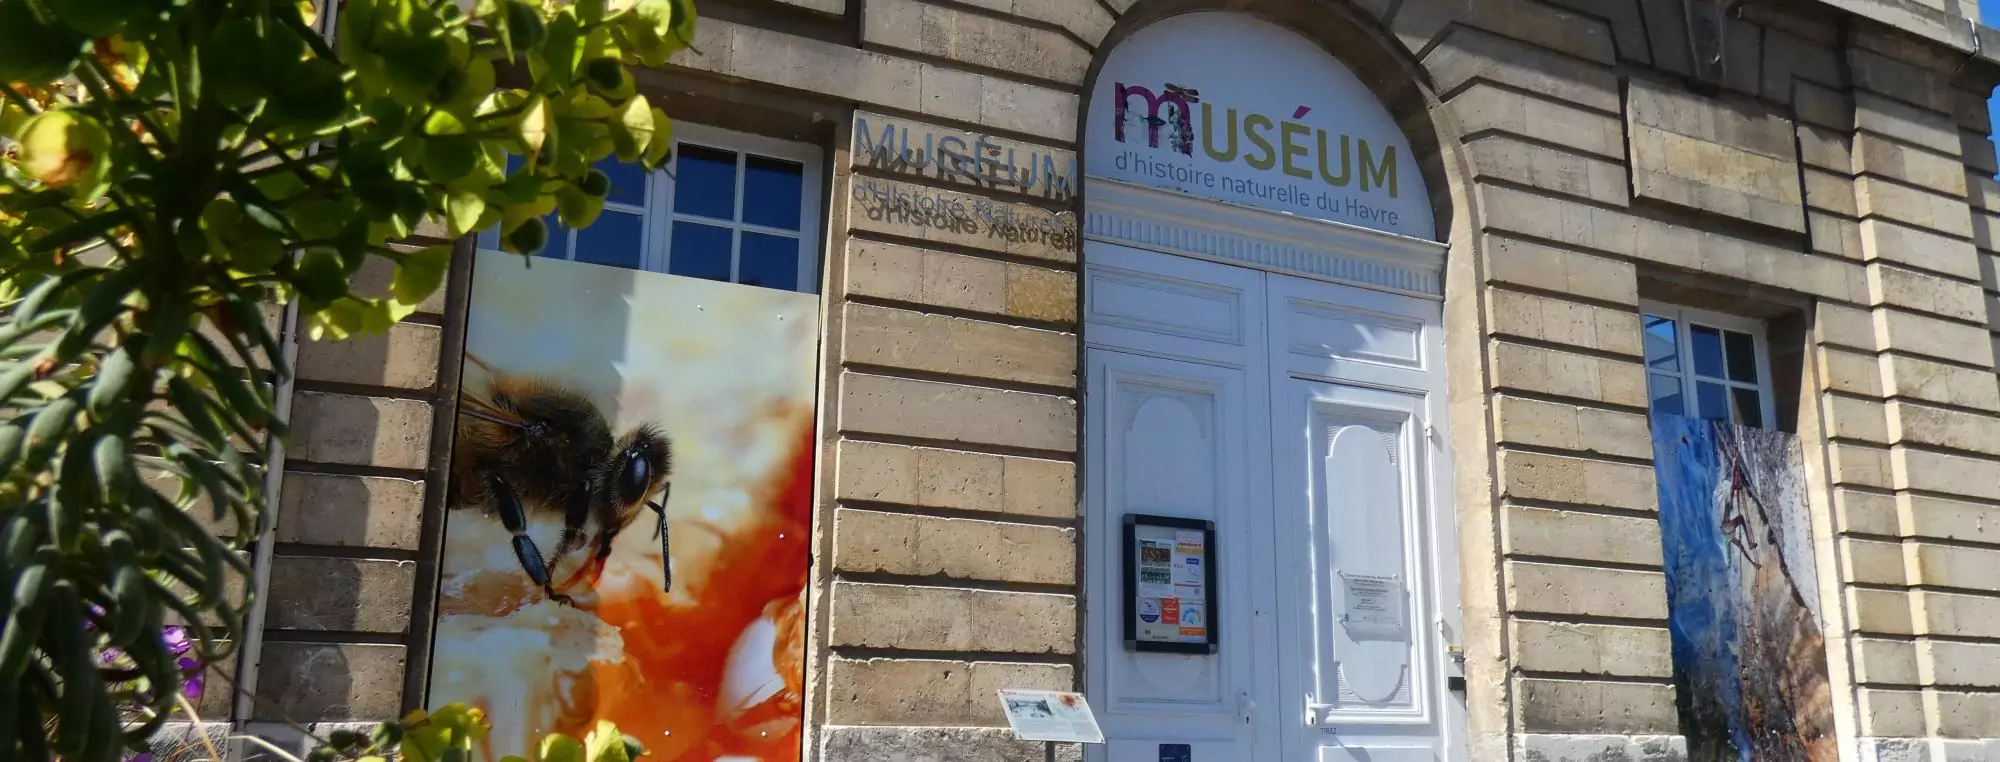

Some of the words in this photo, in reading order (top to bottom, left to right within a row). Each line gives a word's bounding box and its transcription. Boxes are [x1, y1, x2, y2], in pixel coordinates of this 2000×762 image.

[1115, 150, 1215, 188] d'histoire
[1221, 175, 1310, 207] naturelle
[1316, 191, 1340, 213] du
[1345, 197, 1399, 226] Havre
